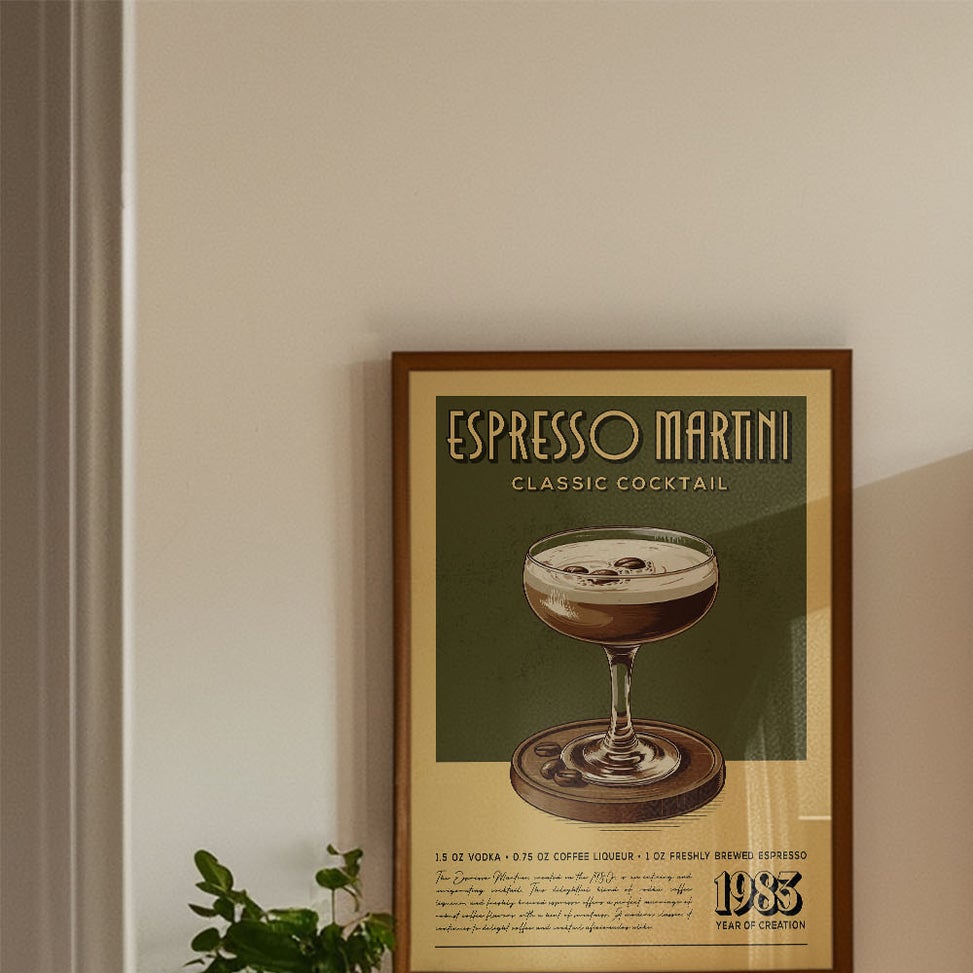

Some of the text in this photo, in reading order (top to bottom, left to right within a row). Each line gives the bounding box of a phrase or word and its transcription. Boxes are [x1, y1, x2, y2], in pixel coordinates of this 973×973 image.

[446, 408, 793, 465] ESPRESSO MARTINI
[511, 475, 729, 492] CLASSIC COCKTAIL
[435, 851, 808, 862] 1.5 OZ VODKA 0.75 OZ COFFEE LIQUEUR 1 OZ FRESHLY BREWED ESPRESSO
[713, 870, 803, 916] 1983
[715, 921, 806, 930] YEAR OF CREATION
